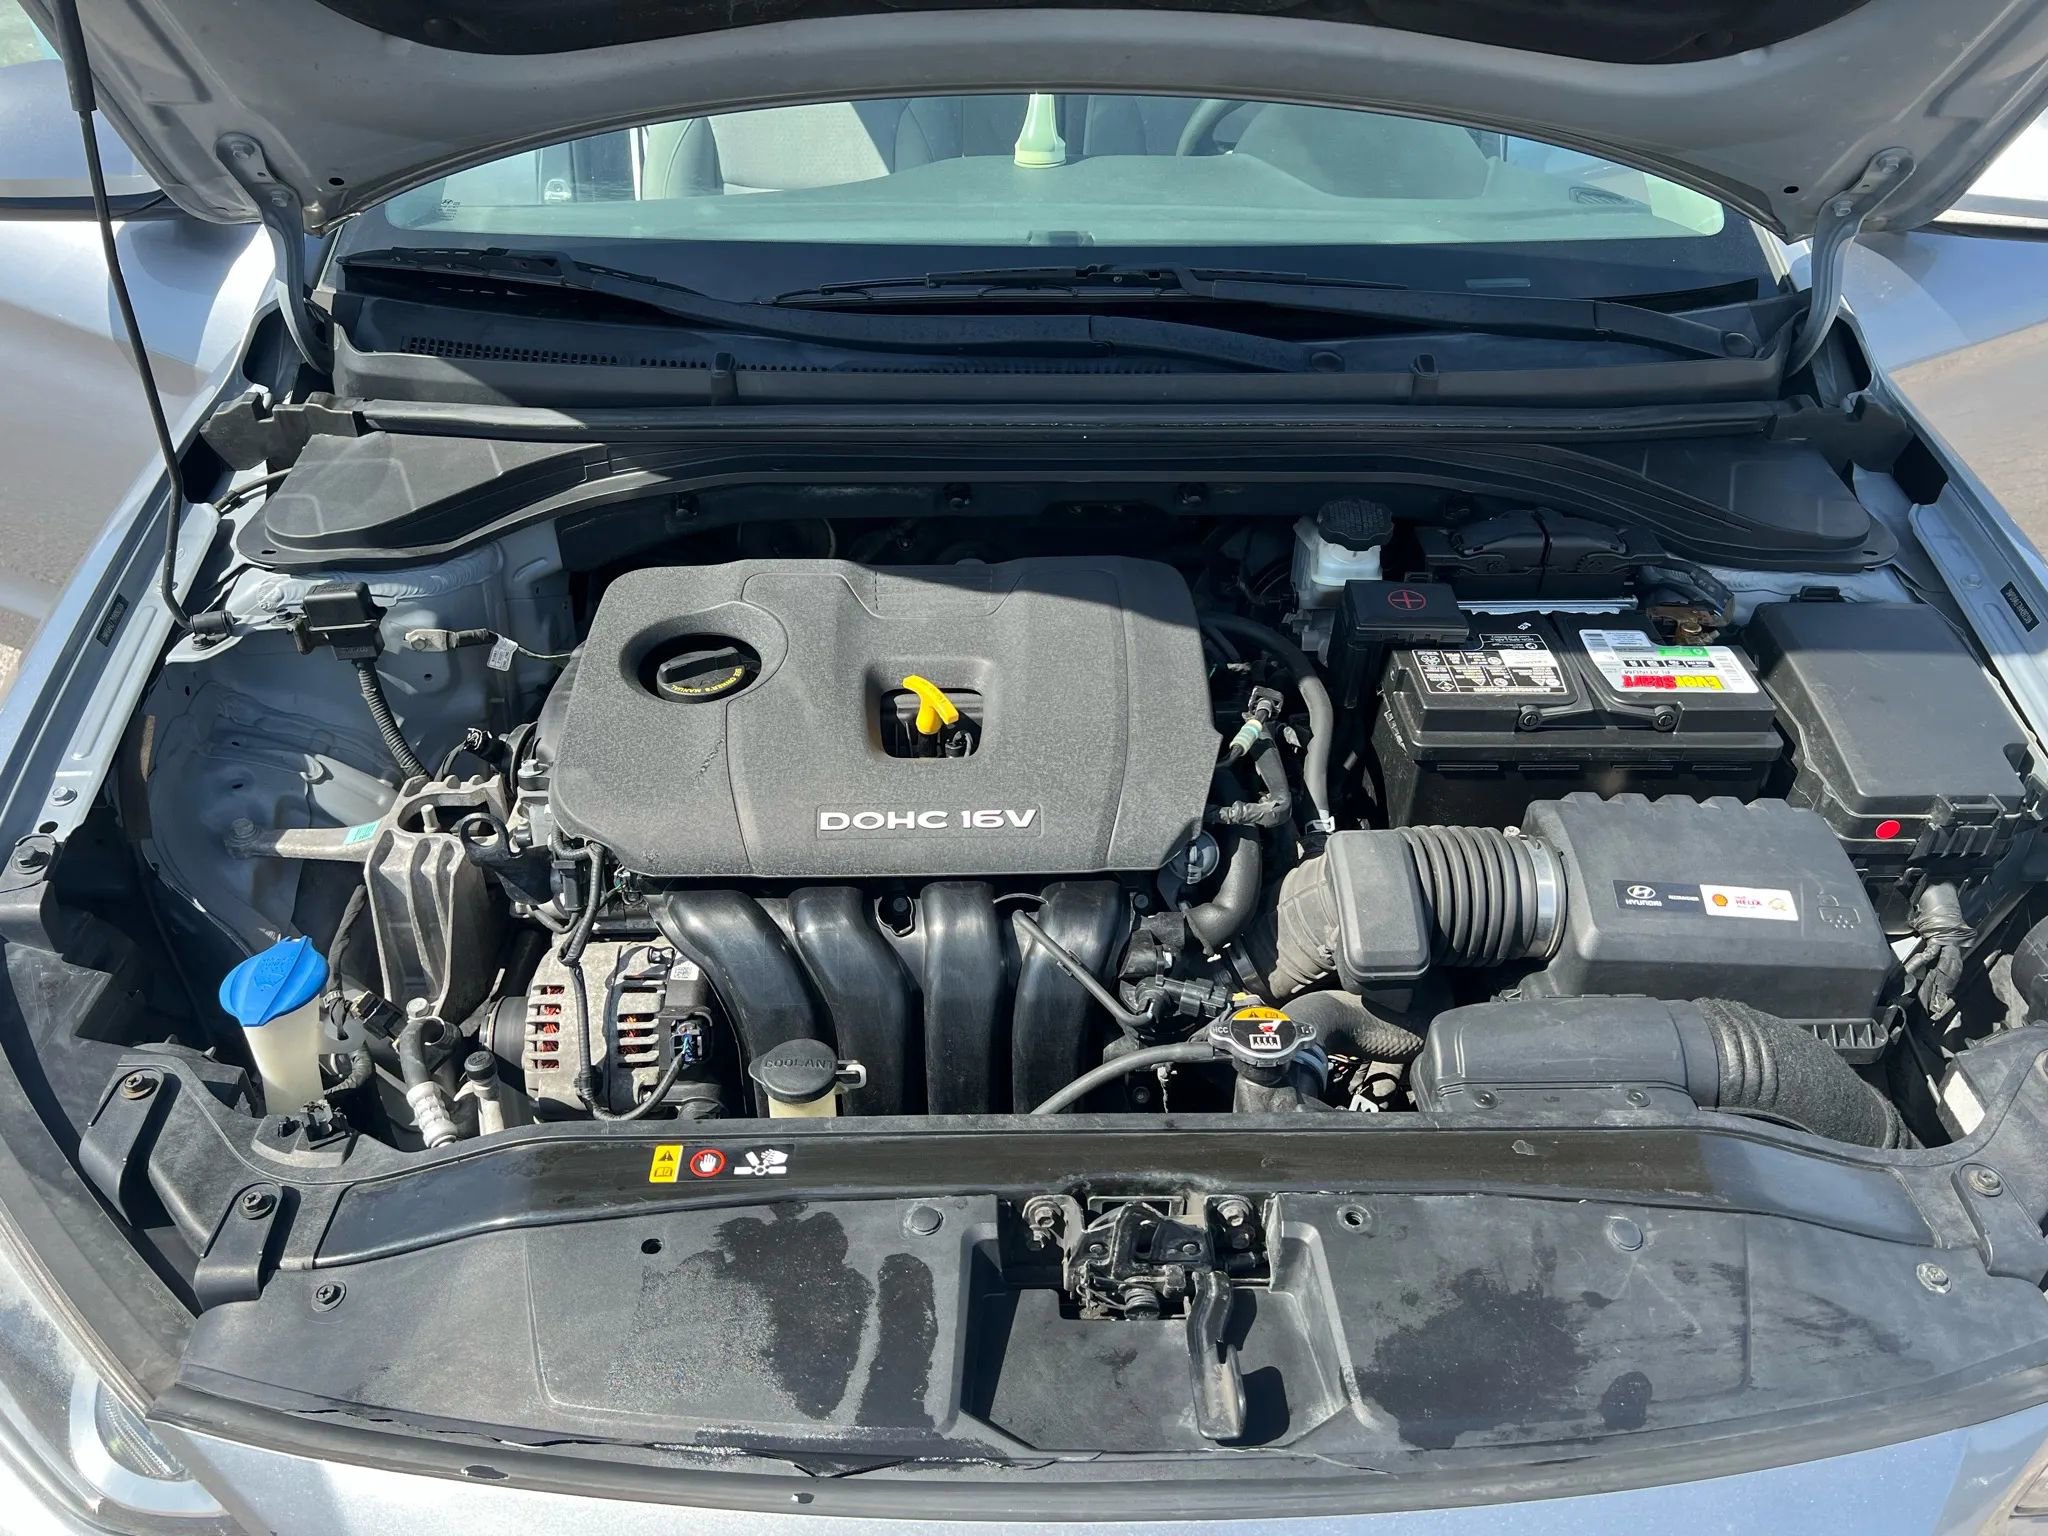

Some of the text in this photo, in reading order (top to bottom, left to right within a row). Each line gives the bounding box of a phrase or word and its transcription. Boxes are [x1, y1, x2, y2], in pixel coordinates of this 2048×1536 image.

[671, 684, 702, 693] MANUAL
[819, 809, 1038, 831] DOHC 16V
[1625, 899, 1662, 907] HYUNDAI
[1212, 1026, 1229, 1034] HCC
[763, 1058, 835, 1071] COOLANT
